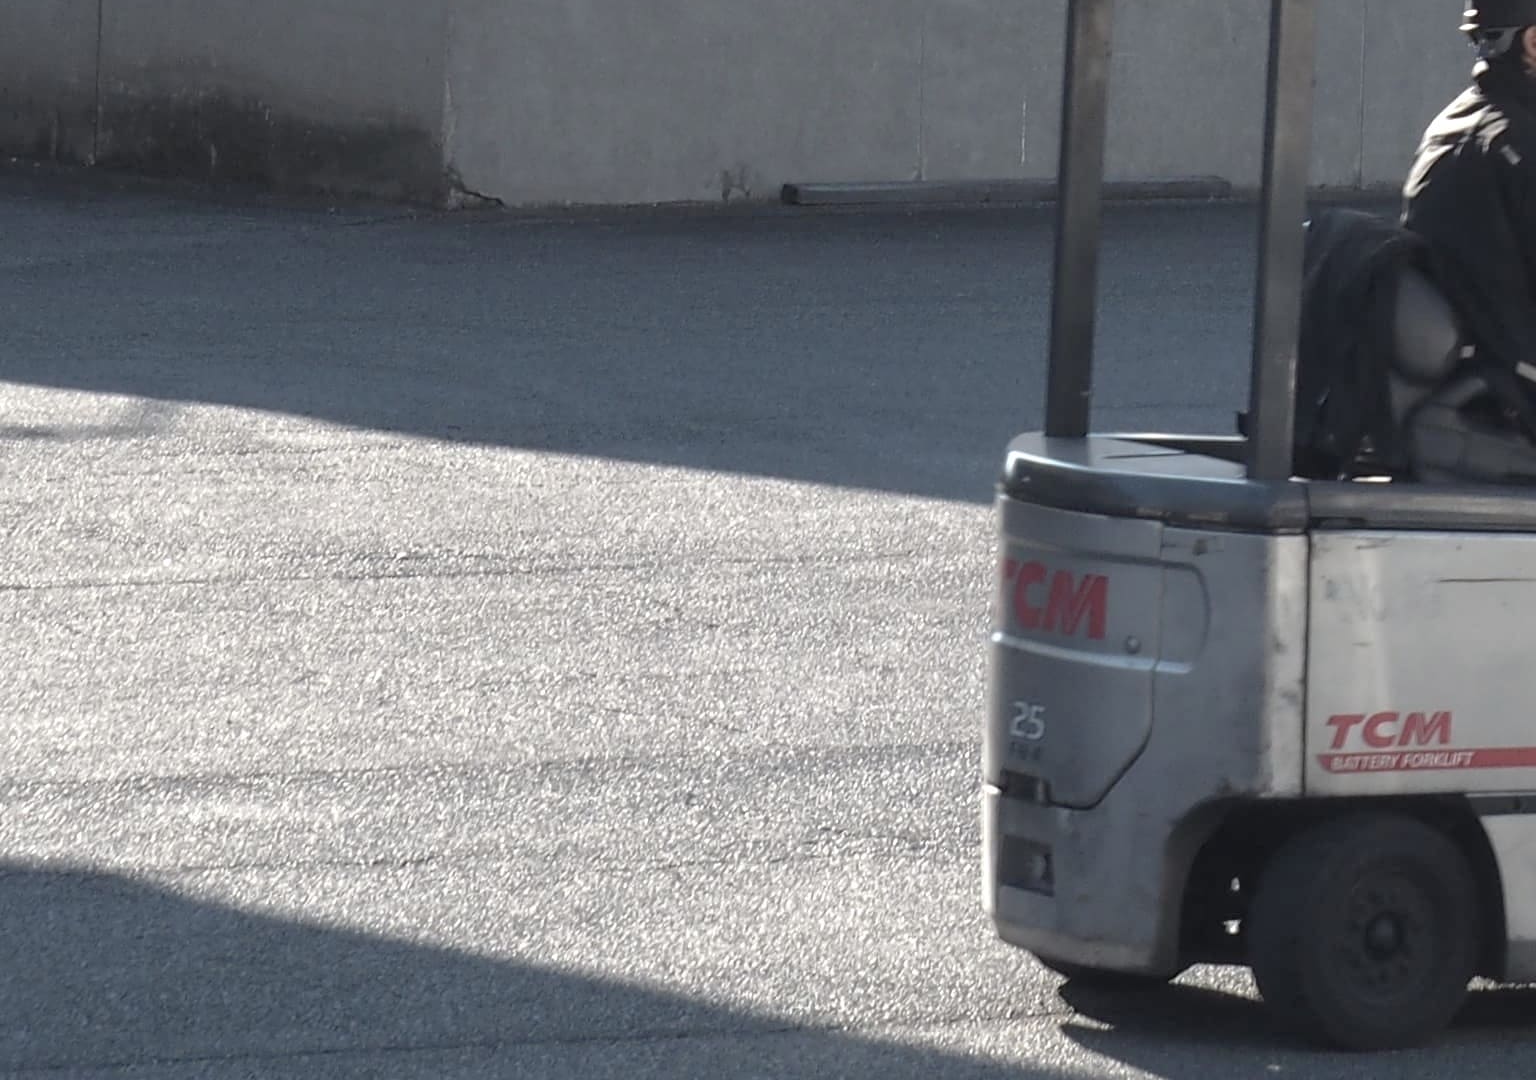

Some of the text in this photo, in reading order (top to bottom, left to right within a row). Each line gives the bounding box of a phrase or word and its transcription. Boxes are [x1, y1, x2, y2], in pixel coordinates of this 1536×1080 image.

[1010, 700, 1046, 740] 25
[1326, 711, 1453, 749] TCM
[1331, 751, 1475, 770] BATTERY FORKLIFT
